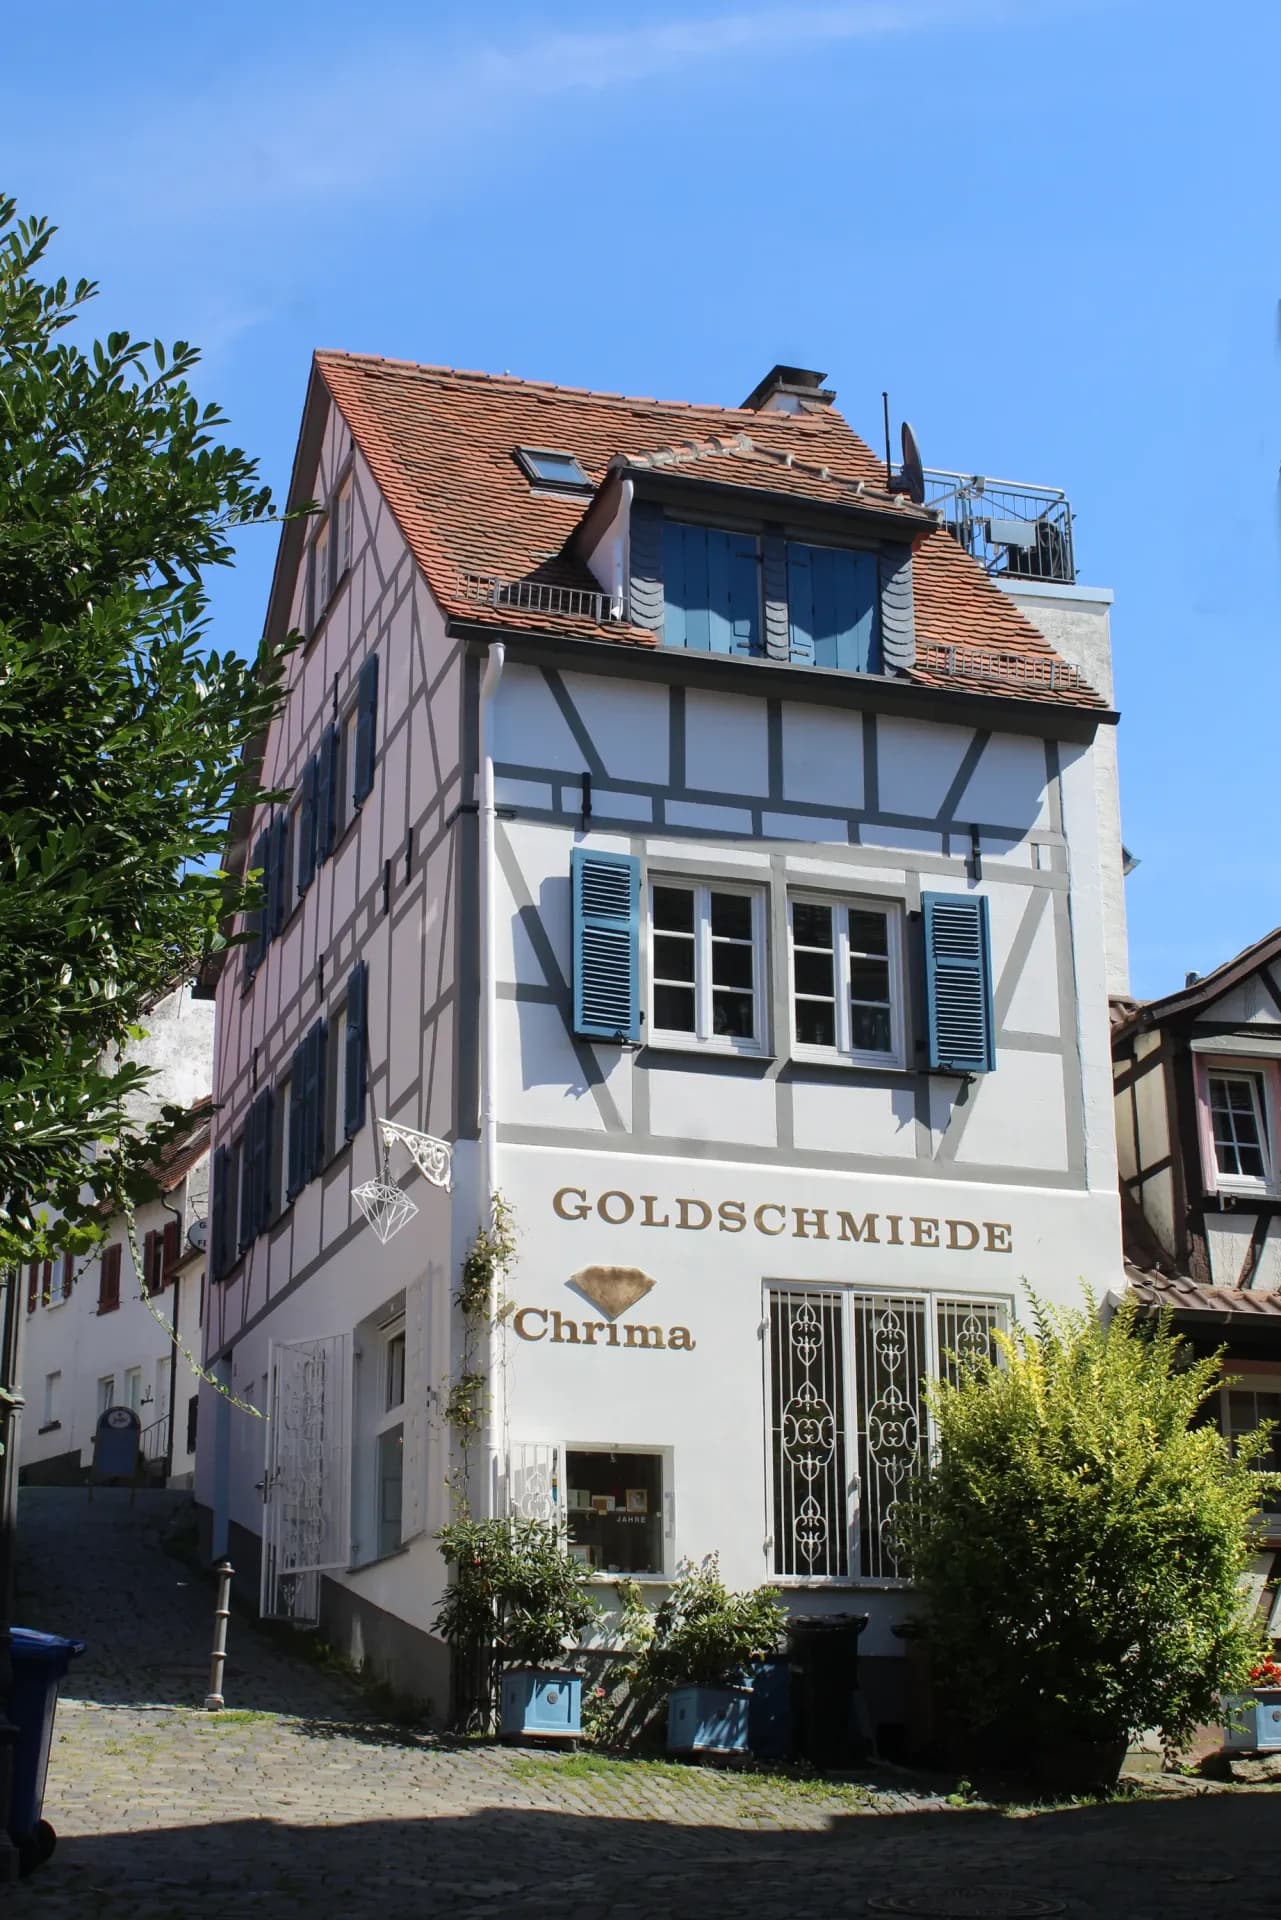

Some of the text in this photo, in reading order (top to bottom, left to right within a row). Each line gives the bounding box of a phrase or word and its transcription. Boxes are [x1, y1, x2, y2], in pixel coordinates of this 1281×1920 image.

[552, 1187, 1013, 1253] GOLDSCHMIEDE
[513, 1307, 696, 1351] Chrima
[616, 1515, 647, 1524] JAHRE
